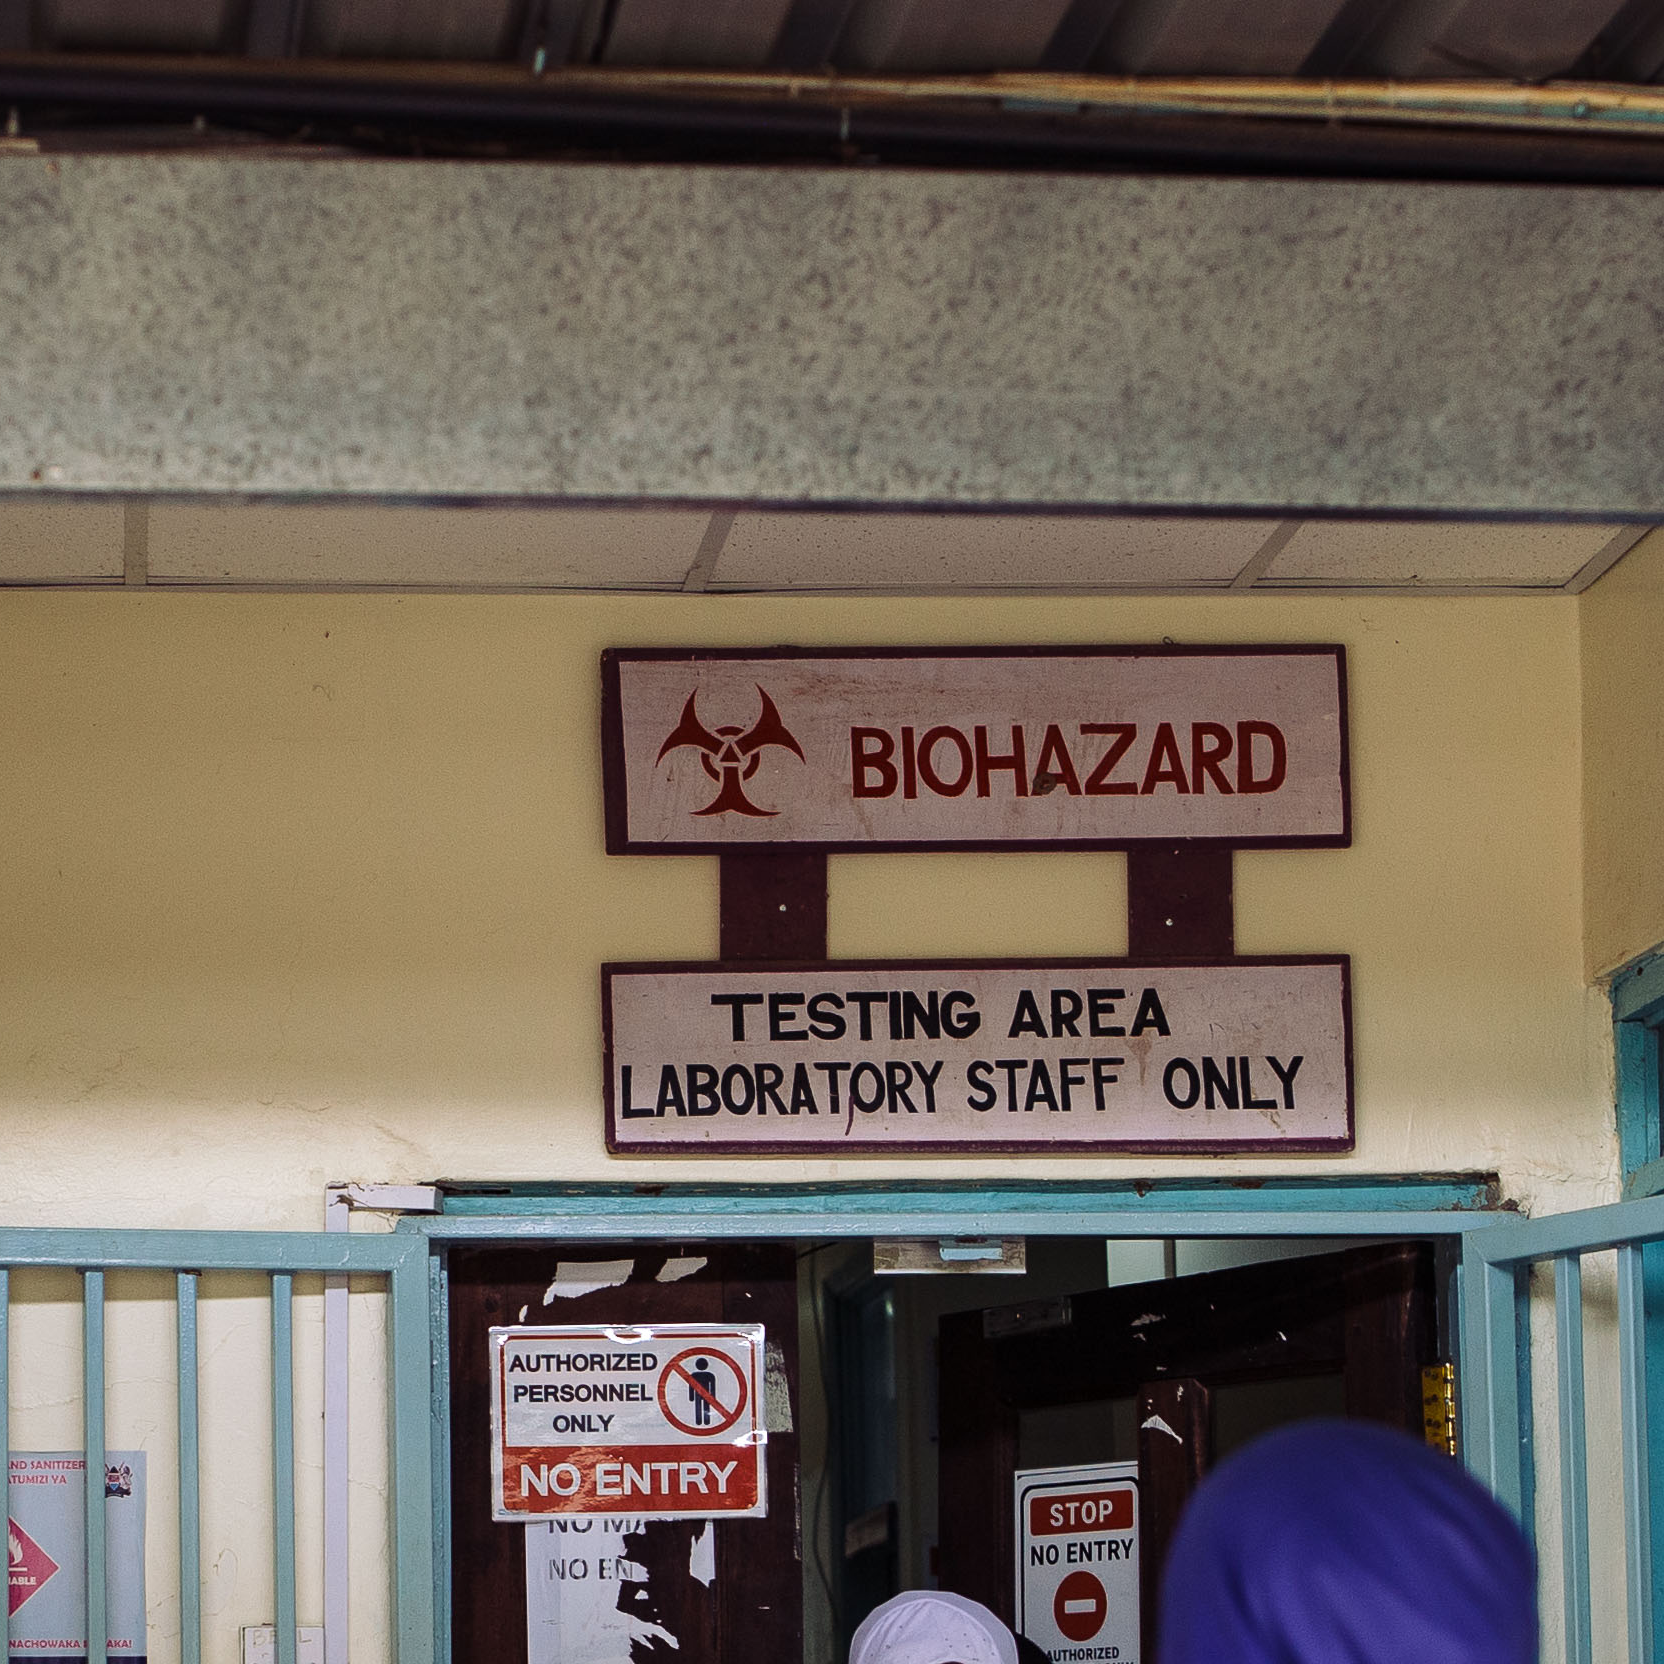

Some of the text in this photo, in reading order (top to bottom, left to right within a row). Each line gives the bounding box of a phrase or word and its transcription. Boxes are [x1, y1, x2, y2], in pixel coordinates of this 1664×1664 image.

[850, 720, 1288, 799] BIOHAZARD
[711, 987, 1171, 1041] TESTING AREA
[621, 1056, 1303, 1119] LABORATORY STAFF ONLY
[509, 1353, 658, 1373] AUTHORIZED
[514, 1383, 653, 1402] PERSONNEL
[552, 1414, 615, 1433] ONLY
[30, 1460, 86, 1470] SANITIZER
[51, 1475, 67, 1485] YA
[520, 1461, 738, 1497] NO ENTRY
[1050, 1499, 1113, 1527] STOP
[1030, 1538, 1134, 1566] NO ENTRY
[548, 1558, 633, 1580] NO EN
[1047, 1647, 1120, 1662] AUTHORIZED
